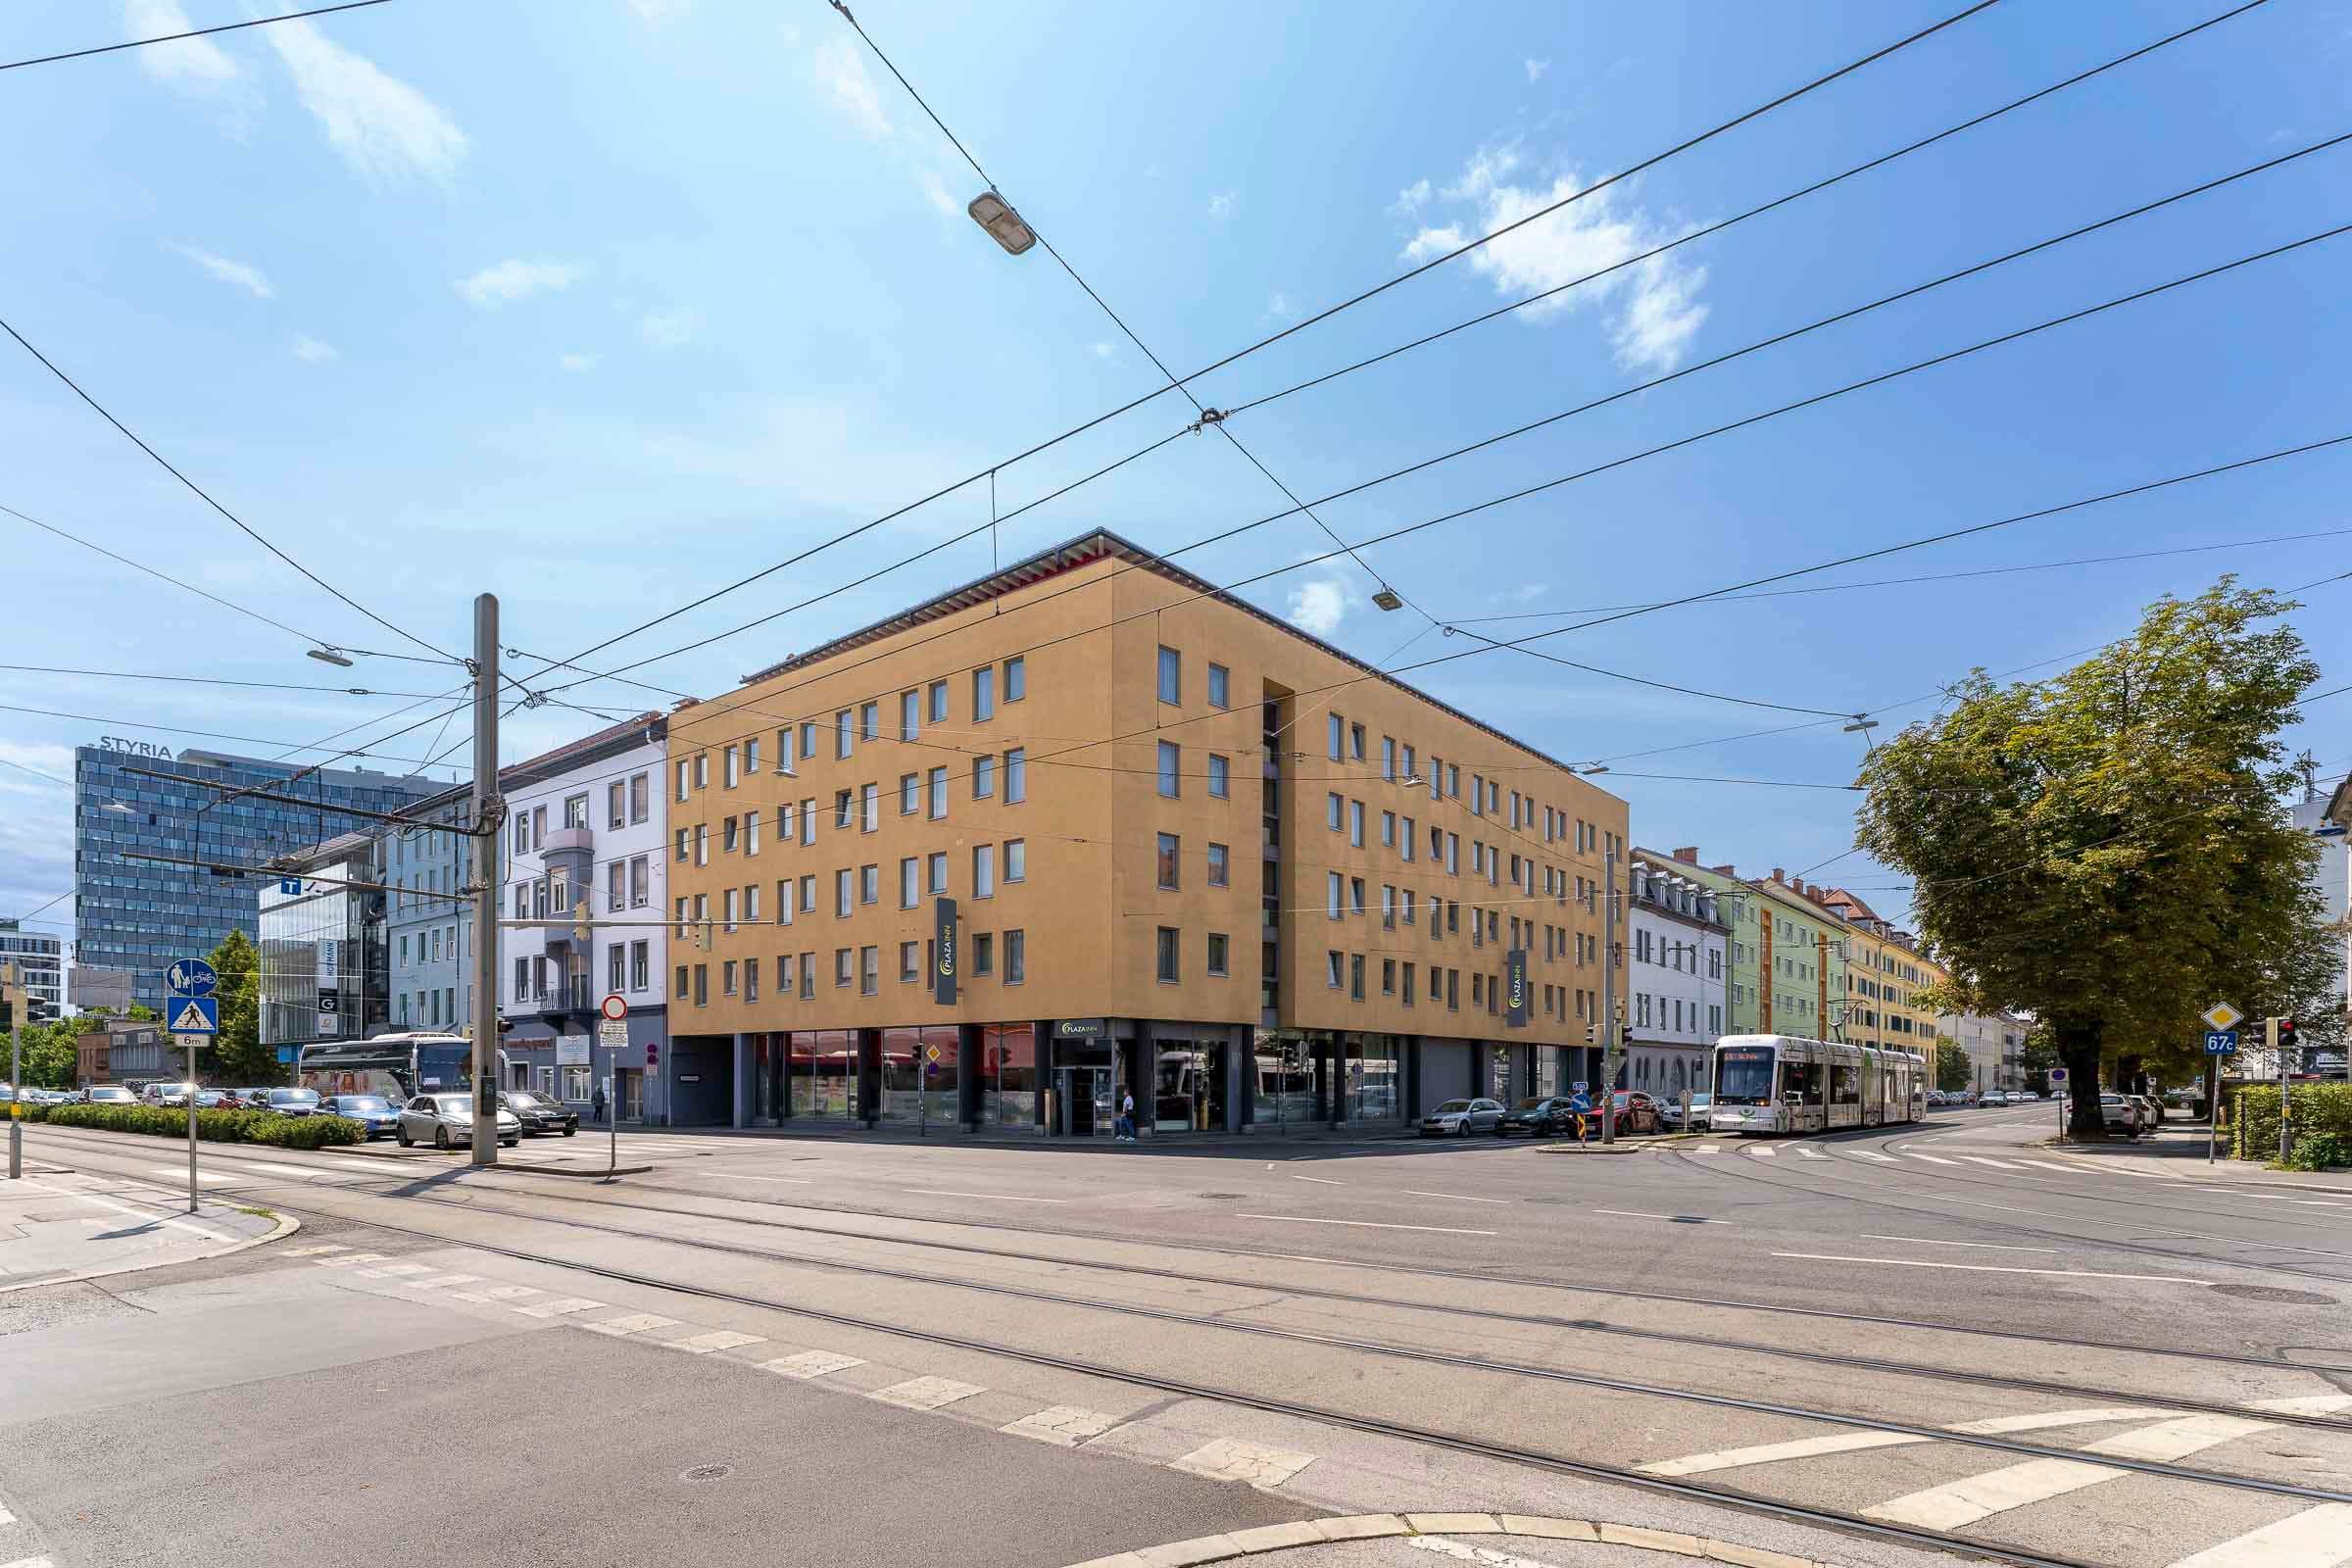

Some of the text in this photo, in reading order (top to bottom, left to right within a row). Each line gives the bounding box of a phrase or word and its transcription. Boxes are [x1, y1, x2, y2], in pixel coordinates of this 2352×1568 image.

[100, 736, 172, 760] STYRIA
[321, 999, 334, 1009] G
[2208, 1035, 2233, 1051] 67c
